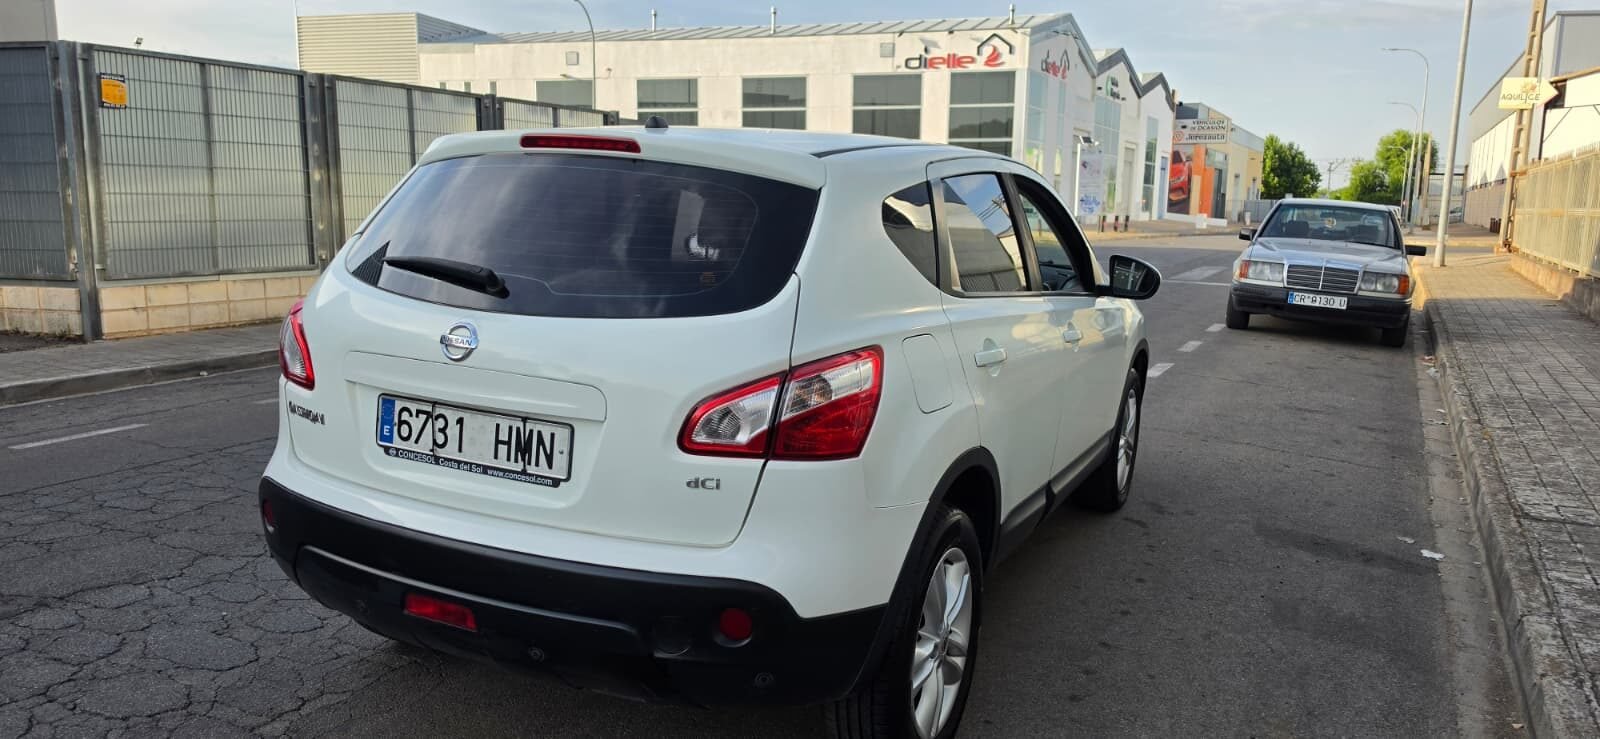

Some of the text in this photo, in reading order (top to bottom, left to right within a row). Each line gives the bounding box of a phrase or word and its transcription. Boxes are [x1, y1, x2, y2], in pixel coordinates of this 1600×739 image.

[904, 49, 977, 70] dielle
[383, 406, 556, 470] E 6731 HMN
[398, 450, 553, 486] CONCESOL Costa del Sol www.concesol.com
